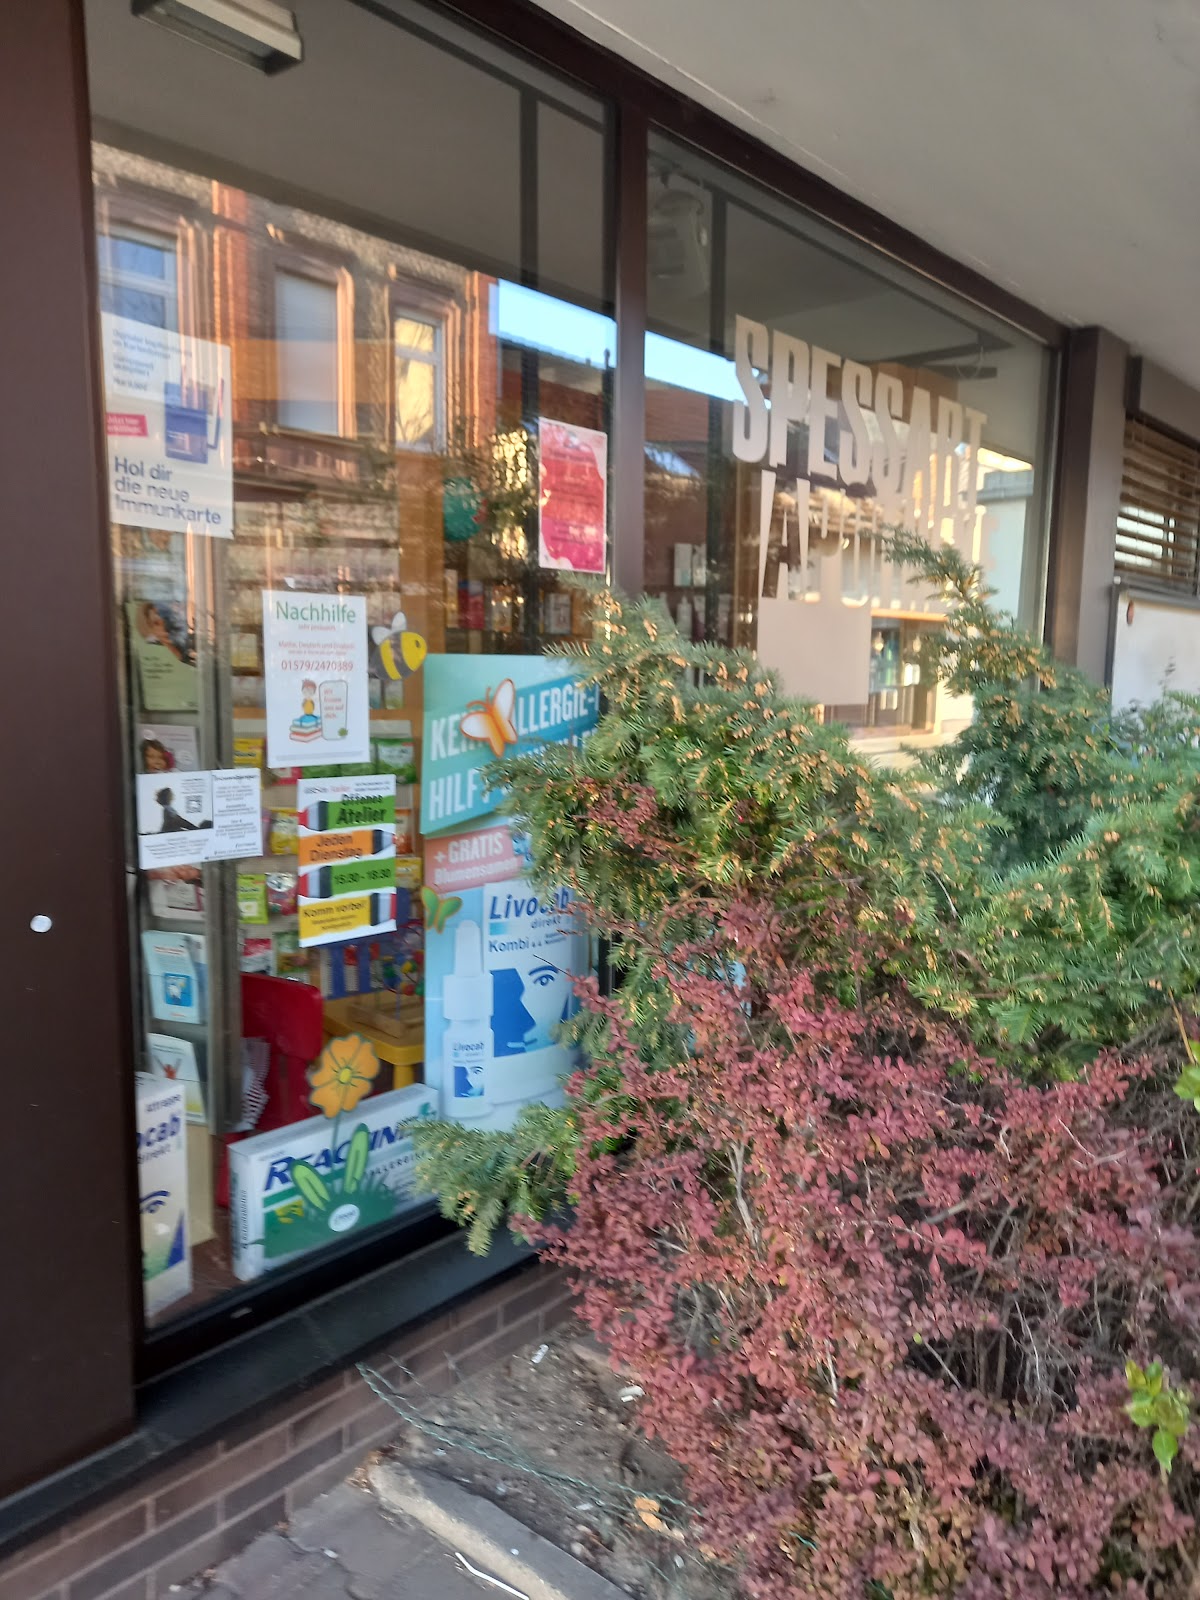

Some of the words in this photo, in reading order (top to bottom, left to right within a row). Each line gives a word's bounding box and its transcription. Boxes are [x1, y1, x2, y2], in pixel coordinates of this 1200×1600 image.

[732, 313, 988, 505] SPESSART
[114, 456, 144, 478] Hol
[150, 465, 173, 482] dir
[114, 477, 142, 495] die
[147, 482, 190, 503] neue
[114, 494, 221, 525] Immunkarte
[276, 600, 356, 624] Nachhilfe
[336, 806, 387, 825] Atelier
[316, 833, 353, 847] Jeden
[448, 832, 504, 864] GRATIS
[310, 847, 363, 861] Dienstag
[303, 906, 334, 918] Komm
[489, 936, 529, 952] Kombi
